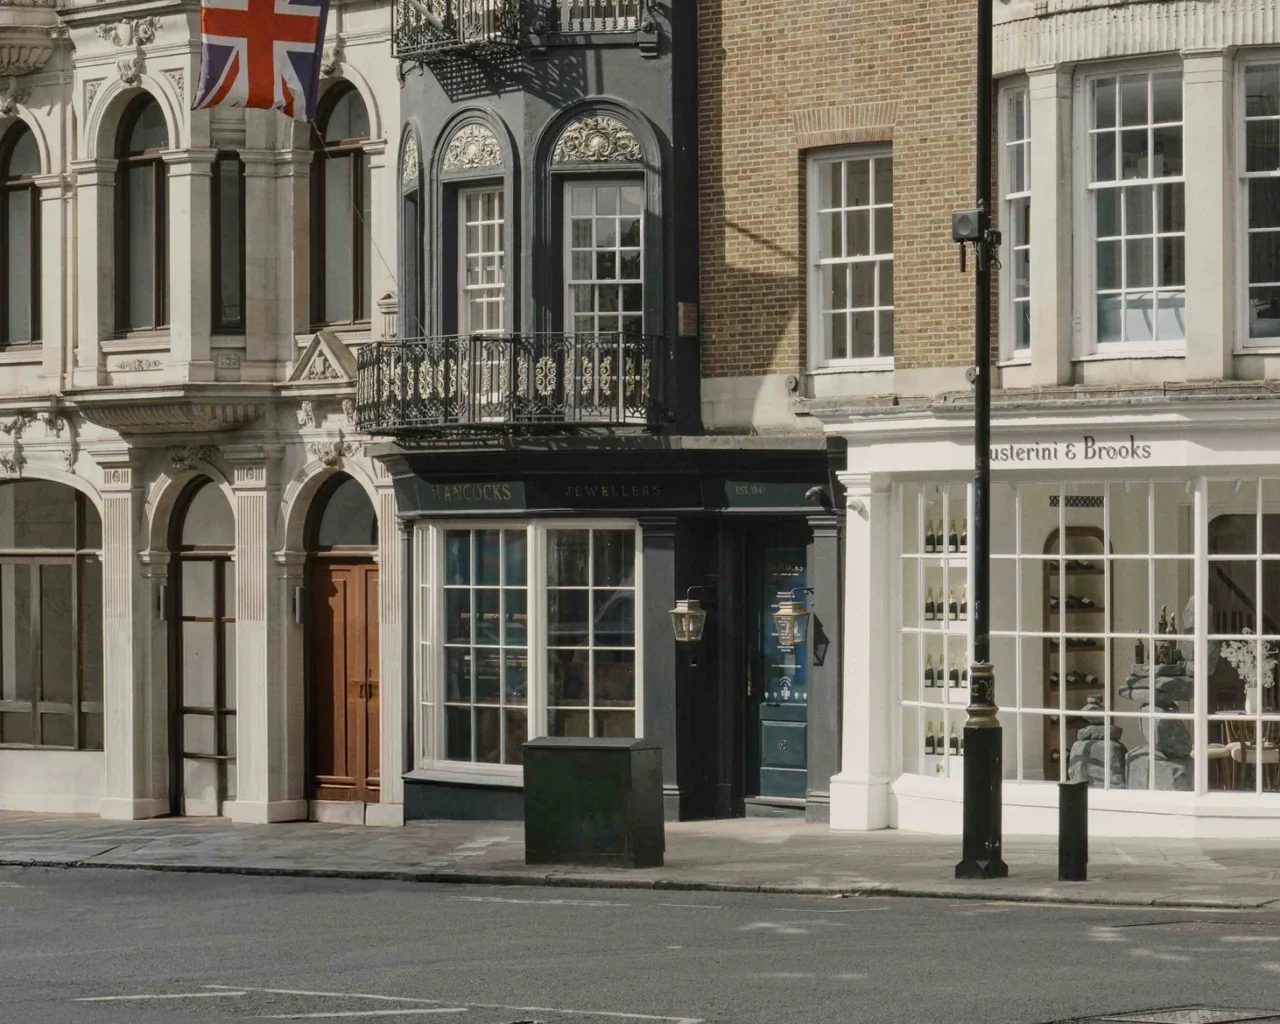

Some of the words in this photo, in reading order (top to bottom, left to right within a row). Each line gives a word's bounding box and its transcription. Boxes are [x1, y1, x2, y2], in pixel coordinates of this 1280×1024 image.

[990, 440, 1059, 462] usterini
[1065, 442, 1077, 461] &
[1083, 434, 1152, 461] Brooks
[429, 483, 513, 502] HANCOCKS
[565, 484, 662, 498] JEWELLERS
